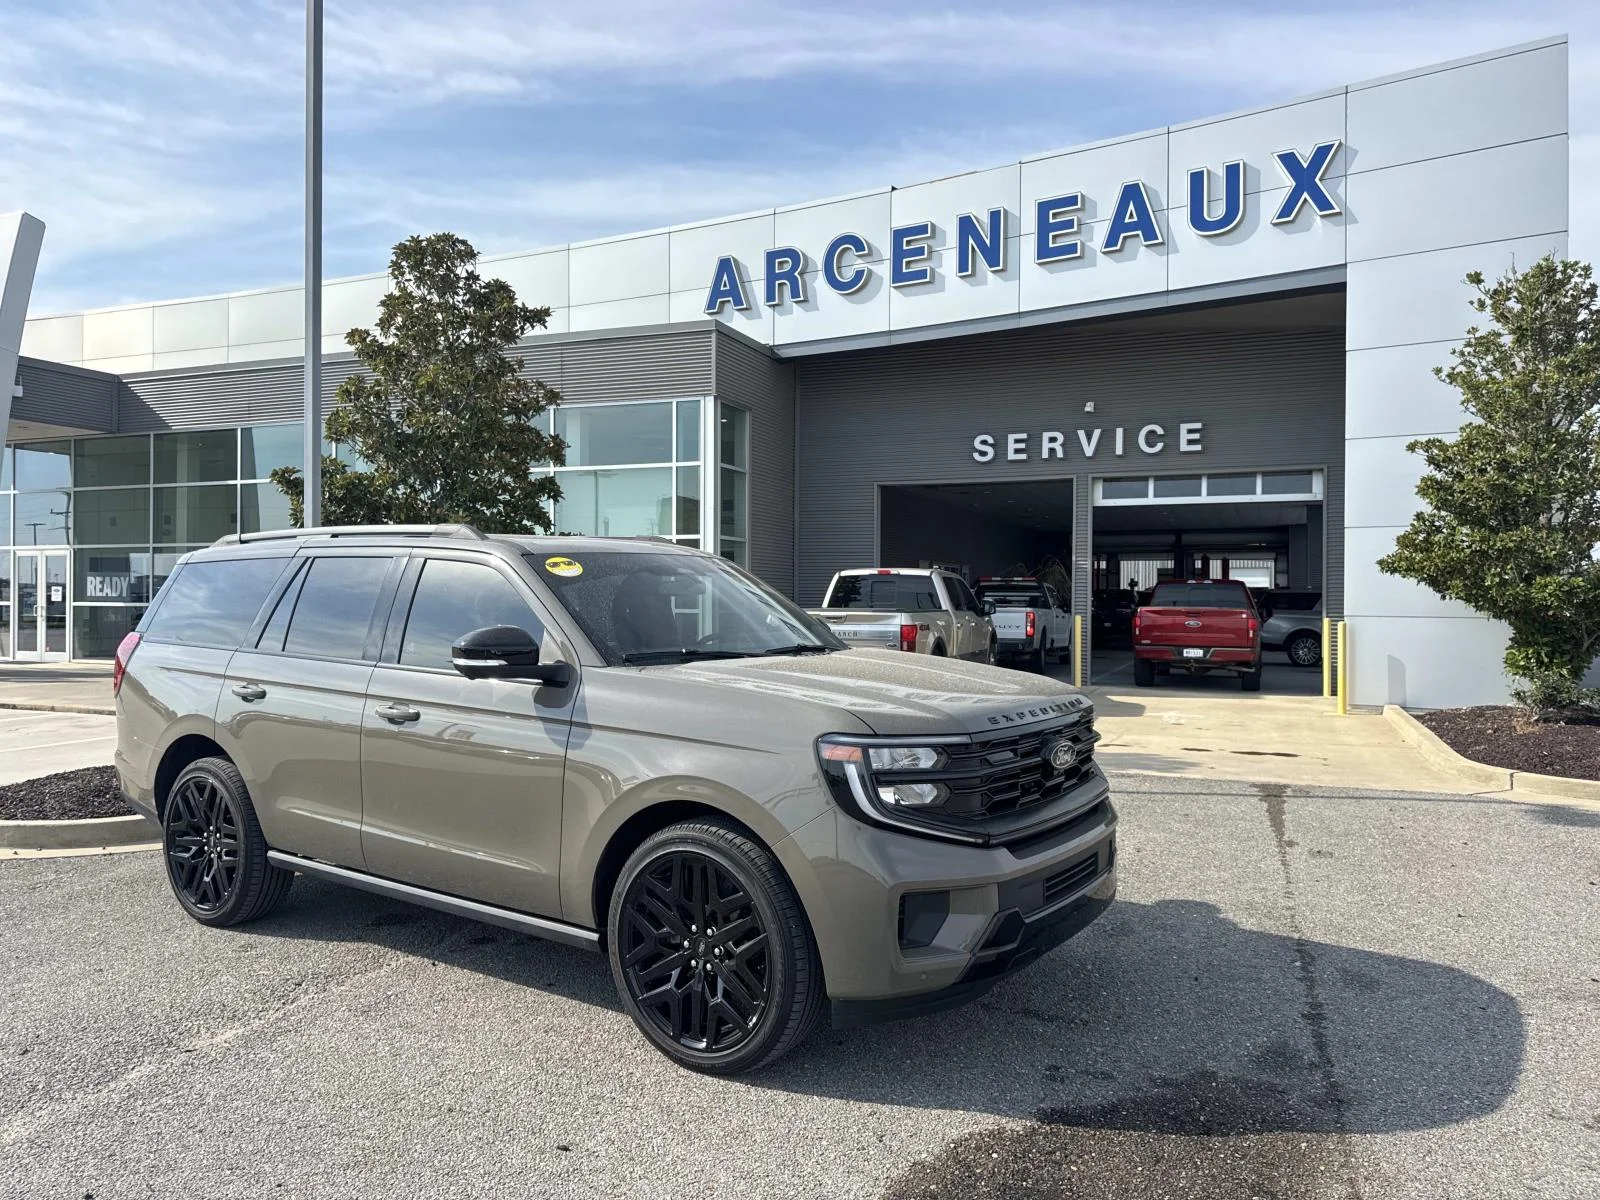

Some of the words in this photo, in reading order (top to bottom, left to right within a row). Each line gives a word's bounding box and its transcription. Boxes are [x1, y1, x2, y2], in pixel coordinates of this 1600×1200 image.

[703, 139, 1342, 314] ARCENEAUX
[972, 422, 1203, 463] SERVICE
[86, 576, 130, 597] READY
[987, 697, 1084, 725] EXPEDITION
